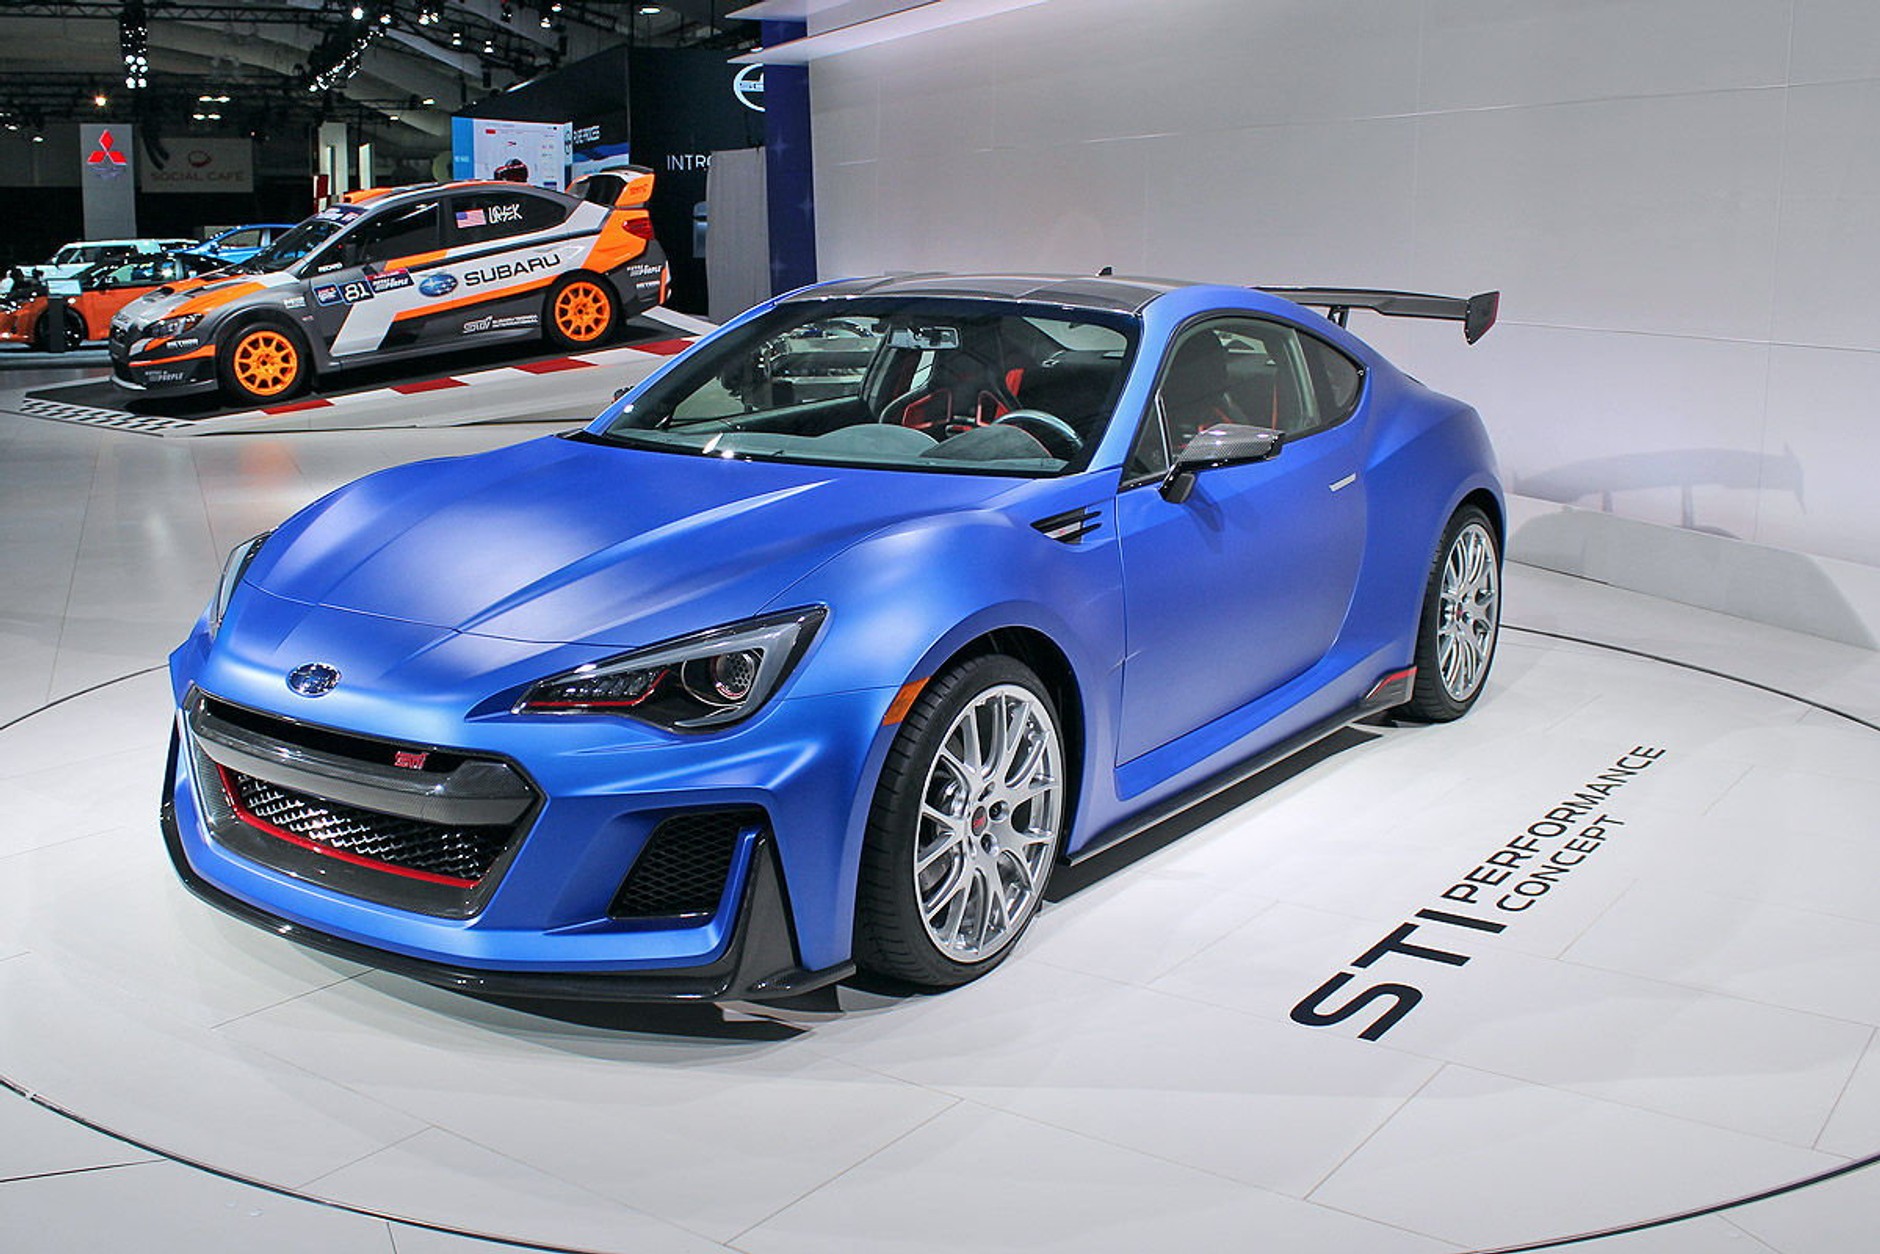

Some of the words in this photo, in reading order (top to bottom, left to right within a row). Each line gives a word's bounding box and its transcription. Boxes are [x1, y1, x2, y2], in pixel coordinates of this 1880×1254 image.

[152, 171, 202, 182] SOCIAL
[207, 171, 244, 182] CAFE
[464, 253, 561, 287] SUBARU
[344, 282, 371, 301] 81
[1496, 814, 1625, 912] CONCEPT
[1289, 907, 1508, 1042] STI
[1440, 745, 1667, 904] PERFORMANCE
